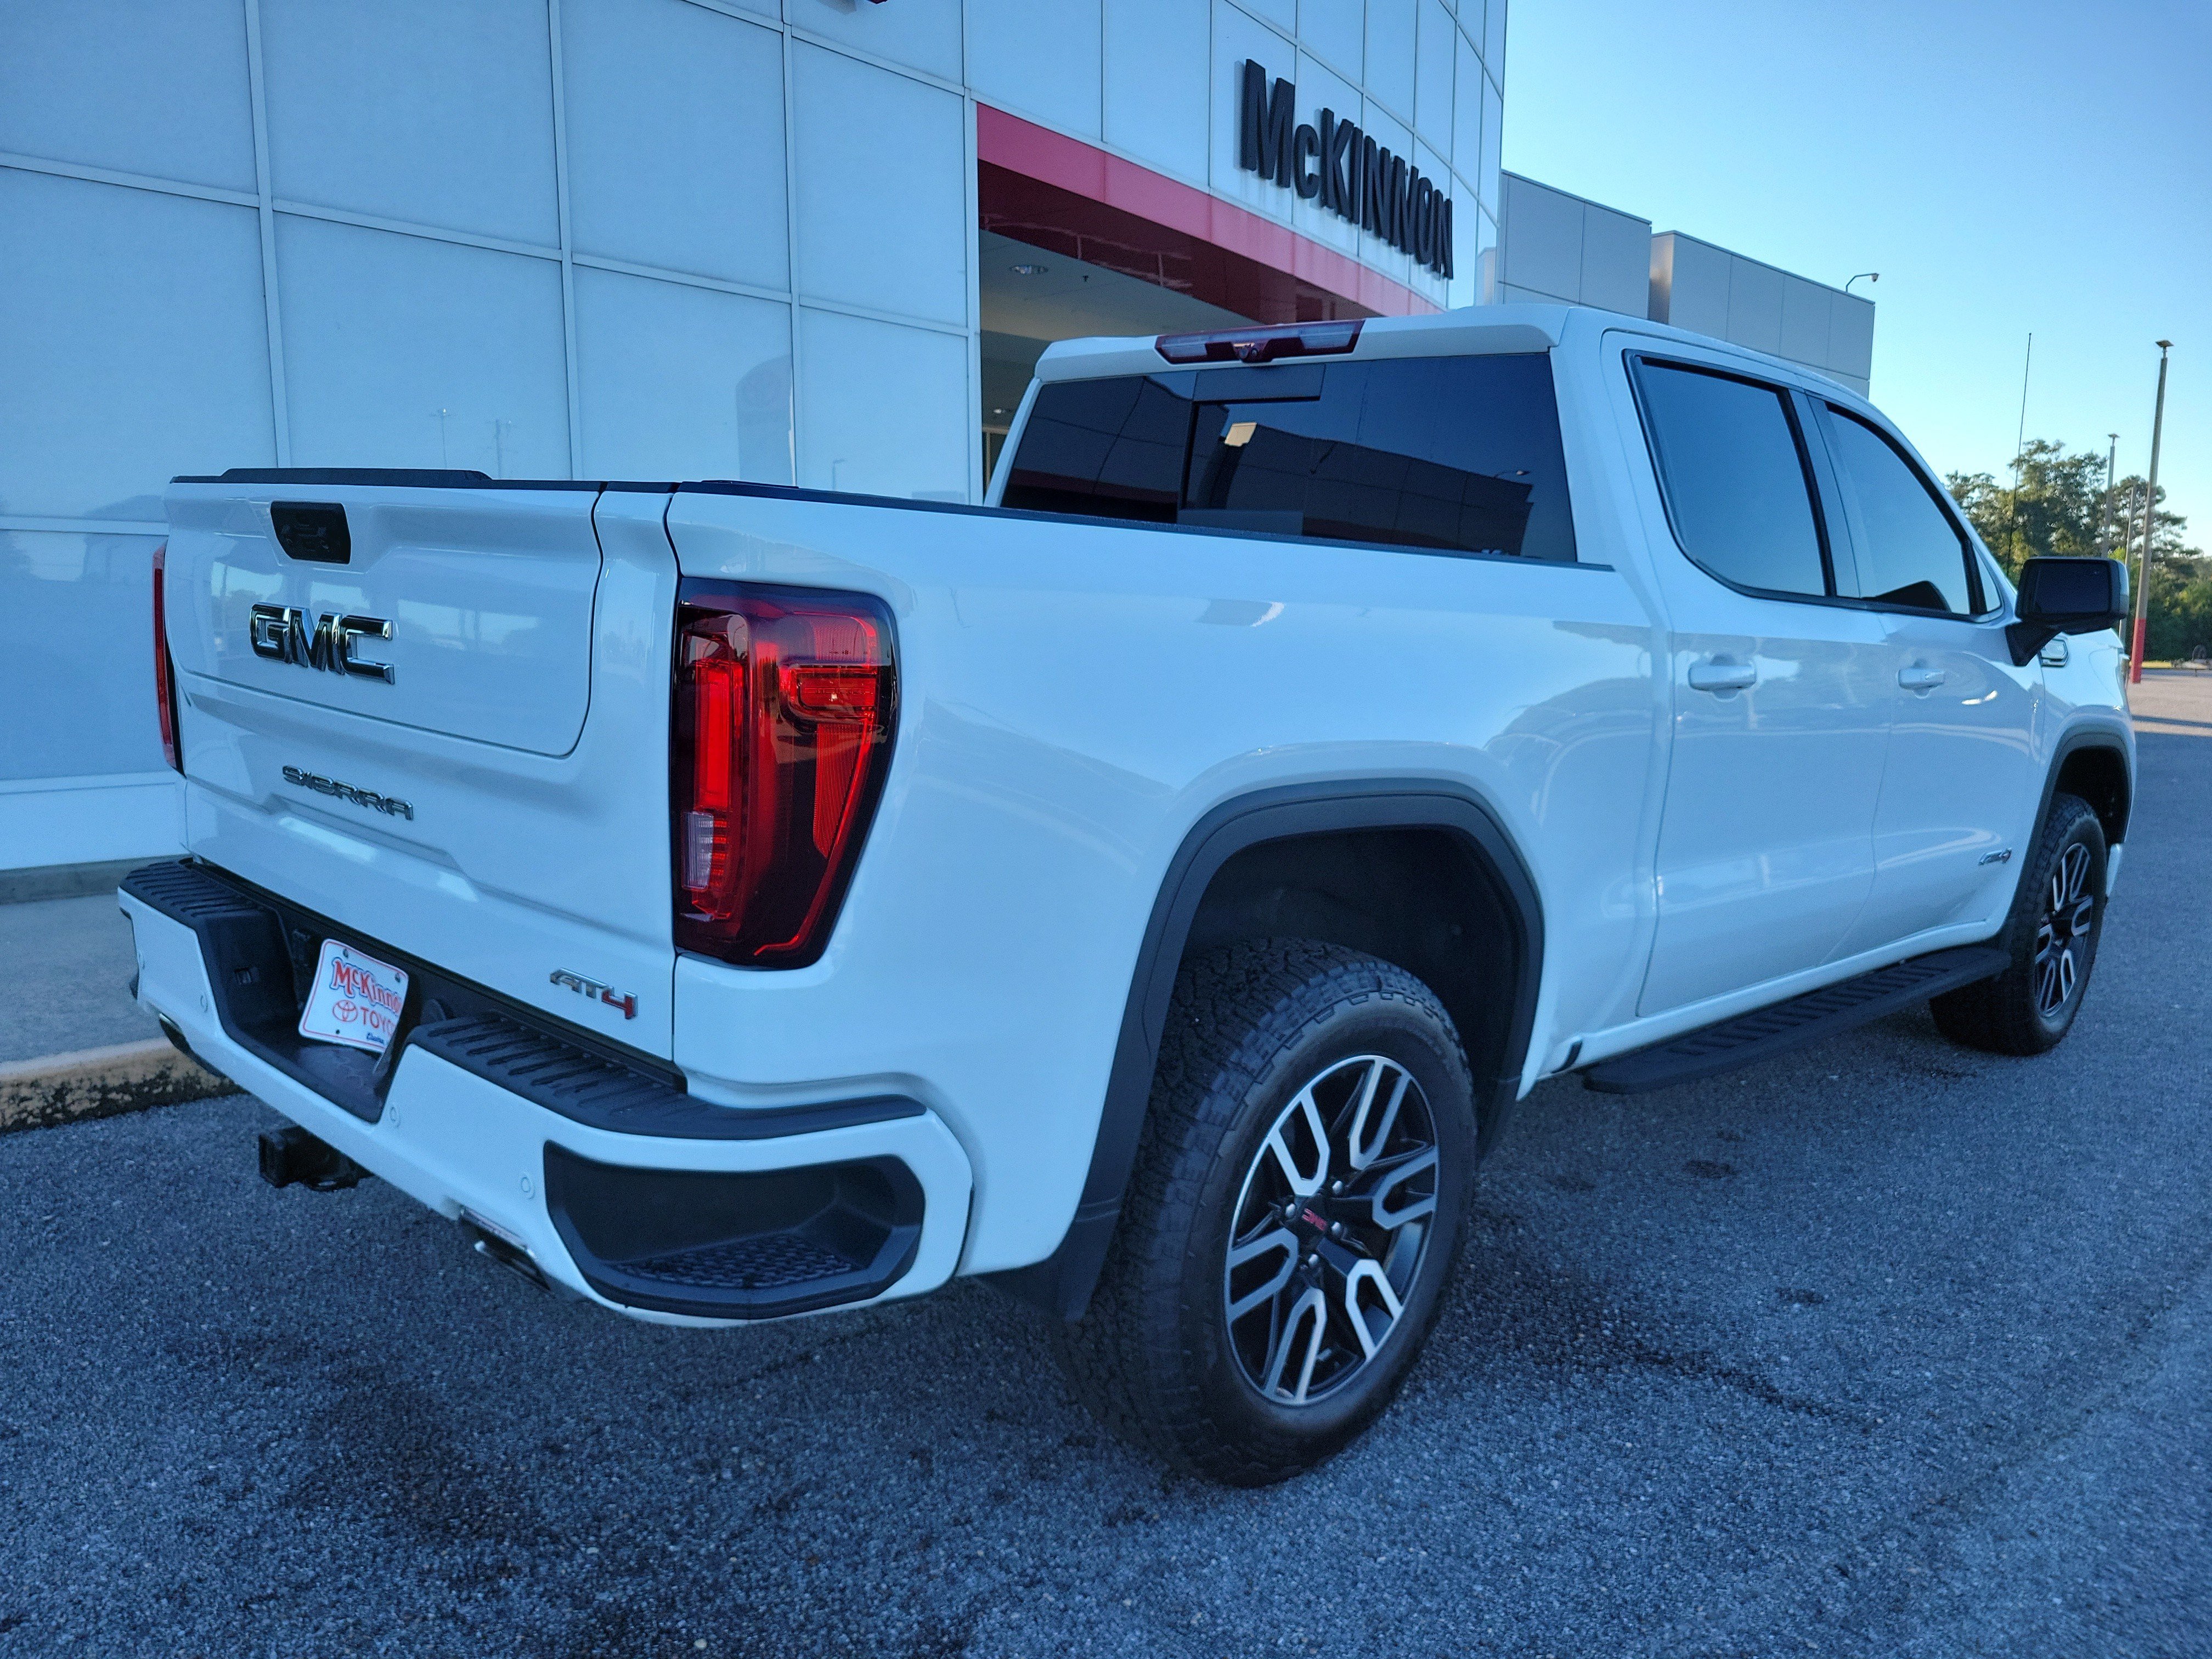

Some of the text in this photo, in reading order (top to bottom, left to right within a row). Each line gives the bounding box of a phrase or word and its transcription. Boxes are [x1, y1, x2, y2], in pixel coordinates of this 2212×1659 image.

[1239, 58, 1453, 280] McKINNON
[249, 602, 396, 685] GMC
[282, 765, 414, 821] SIERRA
[330, 957, 402, 1014] McKinno
[550, 967, 638, 1020] AT4
[359, 1006, 396, 1037] TOYO
